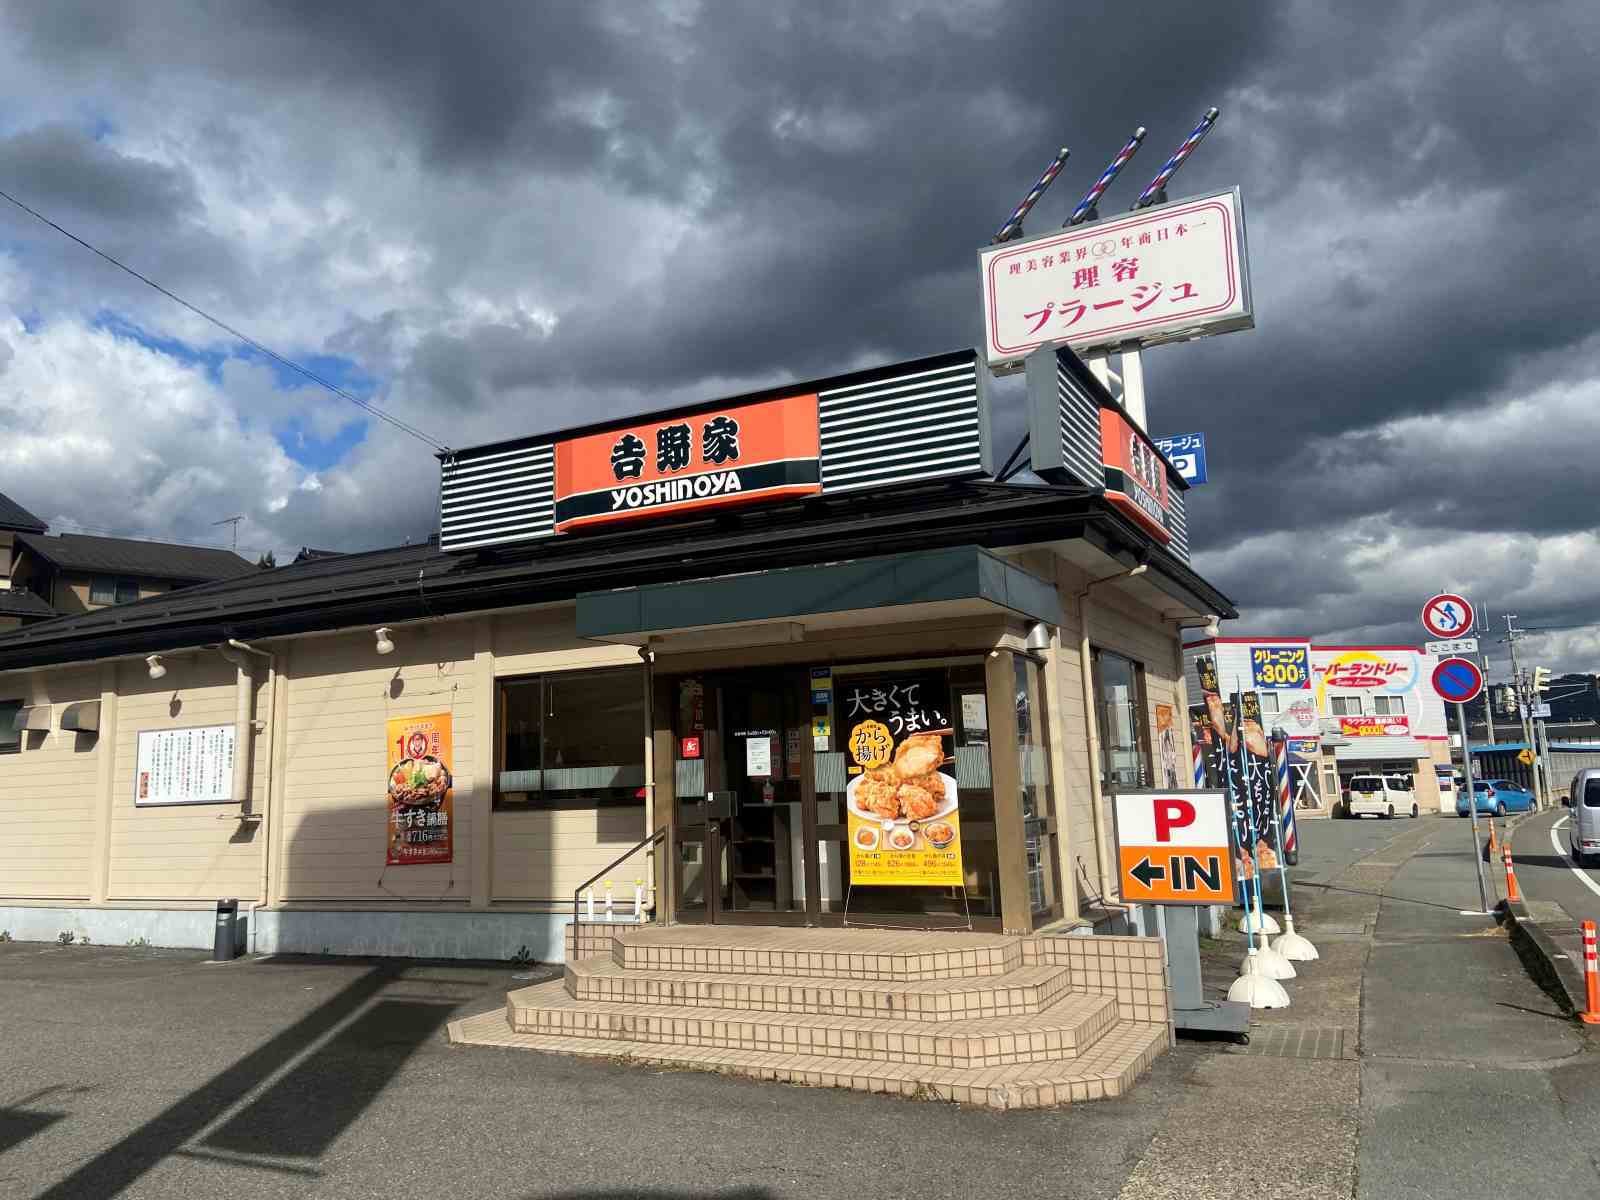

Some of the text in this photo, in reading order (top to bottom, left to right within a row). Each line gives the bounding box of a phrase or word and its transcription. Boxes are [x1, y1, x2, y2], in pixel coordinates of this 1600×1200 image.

[1009, 221, 1207, 275] 理美容業界 年商日本一
[1073, 257, 1140, 290] 理容
[1023, 281, 1199, 335] プラージュ
[610, 416, 740, 481] 吉野家
[611, 471, 742, 510] YOSHINOYA
[1254, 649, 1305, 663] クリーニング
[1312, 662, 1408, 676] ーパーランドリー
[847, 684, 919, 717] 大きくて
[855, 728, 887, 744] から
[889, 707, 948, 735] うまい。
[856, 744, 890, 761] 揚げ
[1153, 799, 1196, 842] P
[1169, 855, 1222, 892] IN
